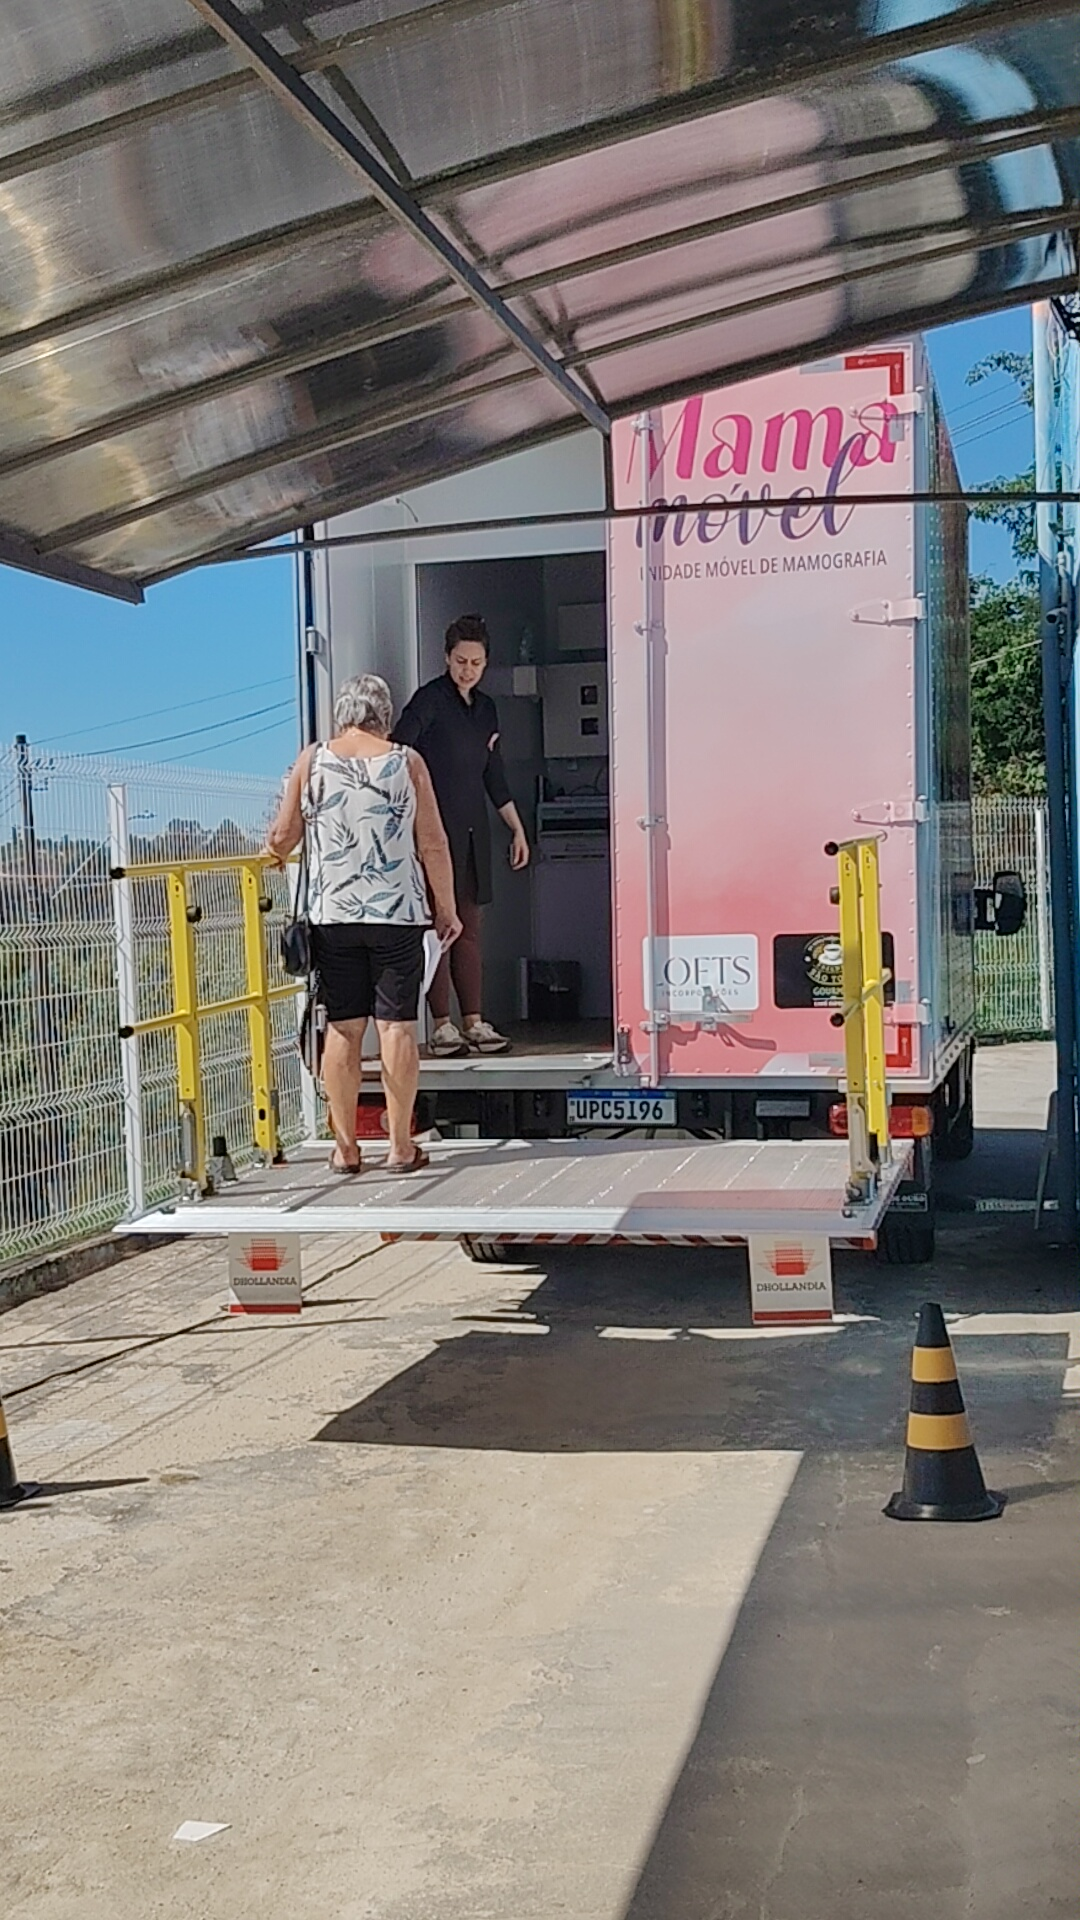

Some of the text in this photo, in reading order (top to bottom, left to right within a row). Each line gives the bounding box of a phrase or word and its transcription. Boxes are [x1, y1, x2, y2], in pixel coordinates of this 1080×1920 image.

[627, 395, 898, 484] Mama
[635, 432, 866, 548] móvel
[705, 556, 756, 578] MÓVEL
[760, 557, 778, 574] DE
[782, 550, 887, 572] MAMOGRAFIA
[656, 956, 750, 986] OFTS
[233, 1277, 297, 1286] DHOLLANDIA
[756, 1281, 826, 1292] DHOLLANDIA
